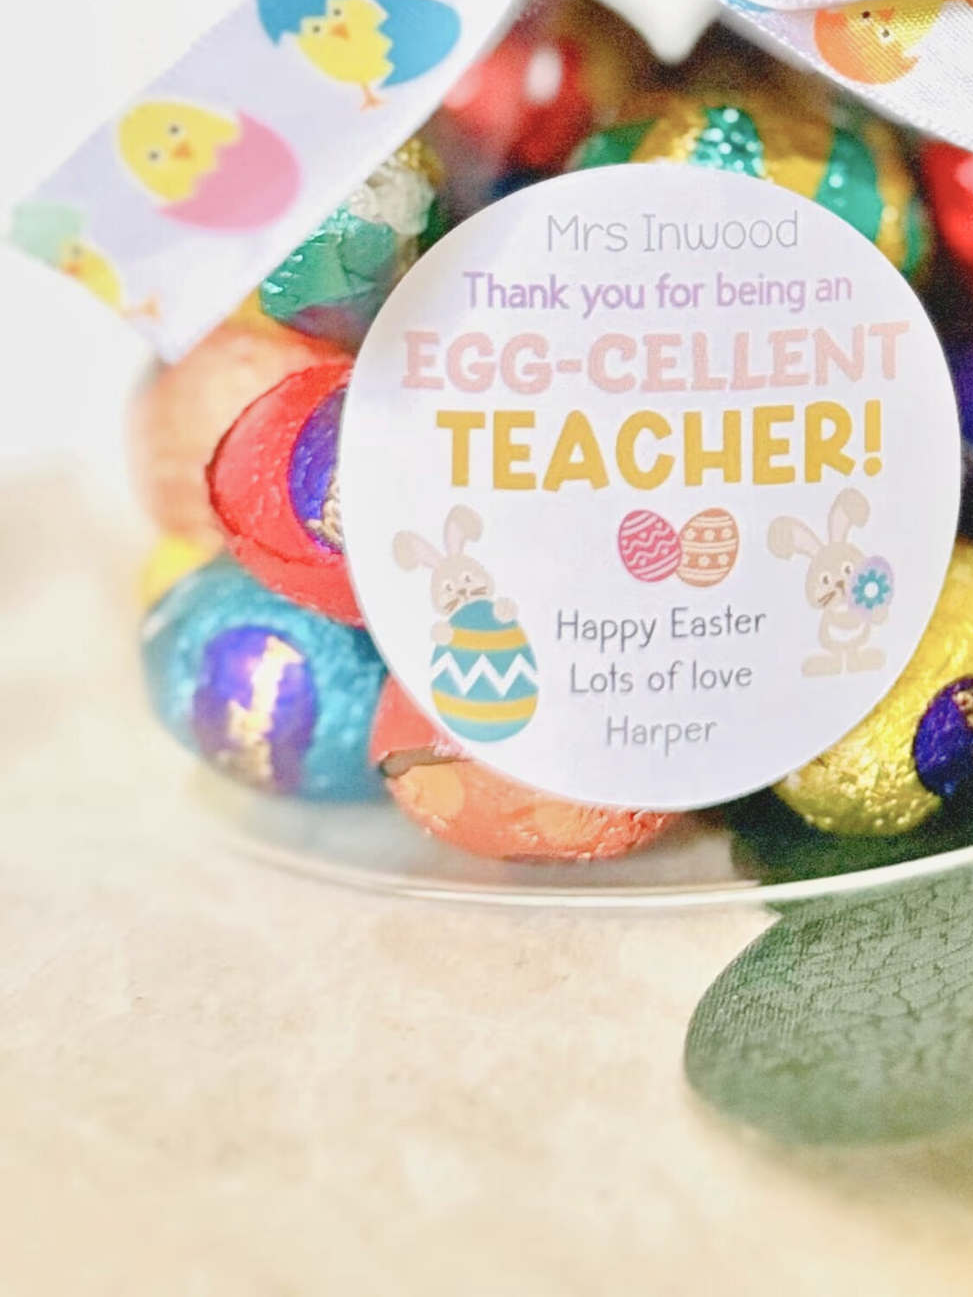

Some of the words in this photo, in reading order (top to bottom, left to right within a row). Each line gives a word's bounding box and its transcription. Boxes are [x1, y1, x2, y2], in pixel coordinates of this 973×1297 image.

[545, 211, 629, 253] Mrs
[642, 209, 799, 253] Inwood
[463, 271, 569, 310] Thank
[580, 281, 646, 319] you
[654, 272, 705, 309] for
[716, 272, 806, 314] being
[814, 273, 853, 303] an
[401, 319, 911, 396] EGG-CELLENT
[436, 399, 883, 492] TEACHER!
[556, 610, 657, 653] Happy
[671, 605, 767, 640] Easter
[571, 662, 634, 694] Lots
[648, 659, 684, 694] of
[692, 659, 753, 691] love
[607, 715, 718, 757] Harper
